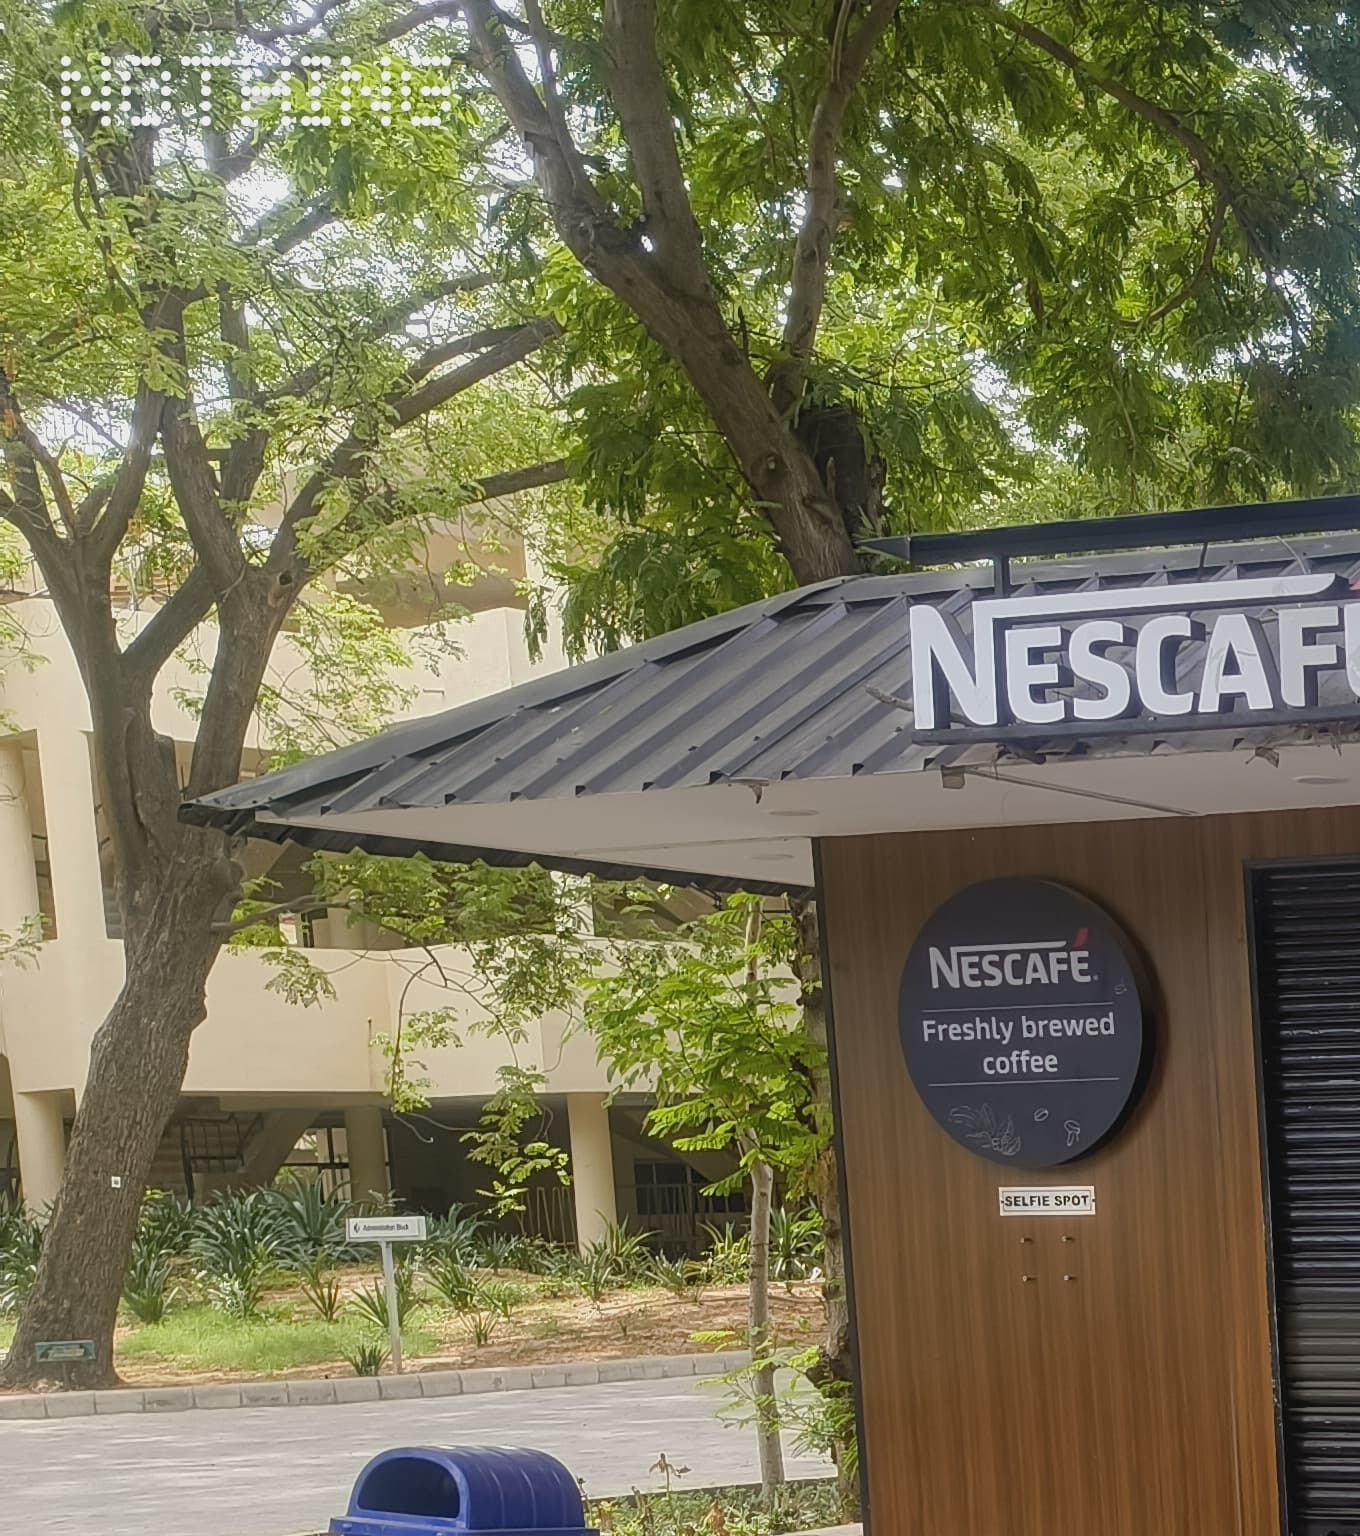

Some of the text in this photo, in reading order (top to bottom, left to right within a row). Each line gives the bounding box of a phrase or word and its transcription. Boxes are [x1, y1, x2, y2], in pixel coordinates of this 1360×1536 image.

[922, 1012, 1115, 1044] Freshly brewed
[983, 1050, 1058, 1075] coffee
[1004, 1195, 1090, 1208] SELFIE SPOT
